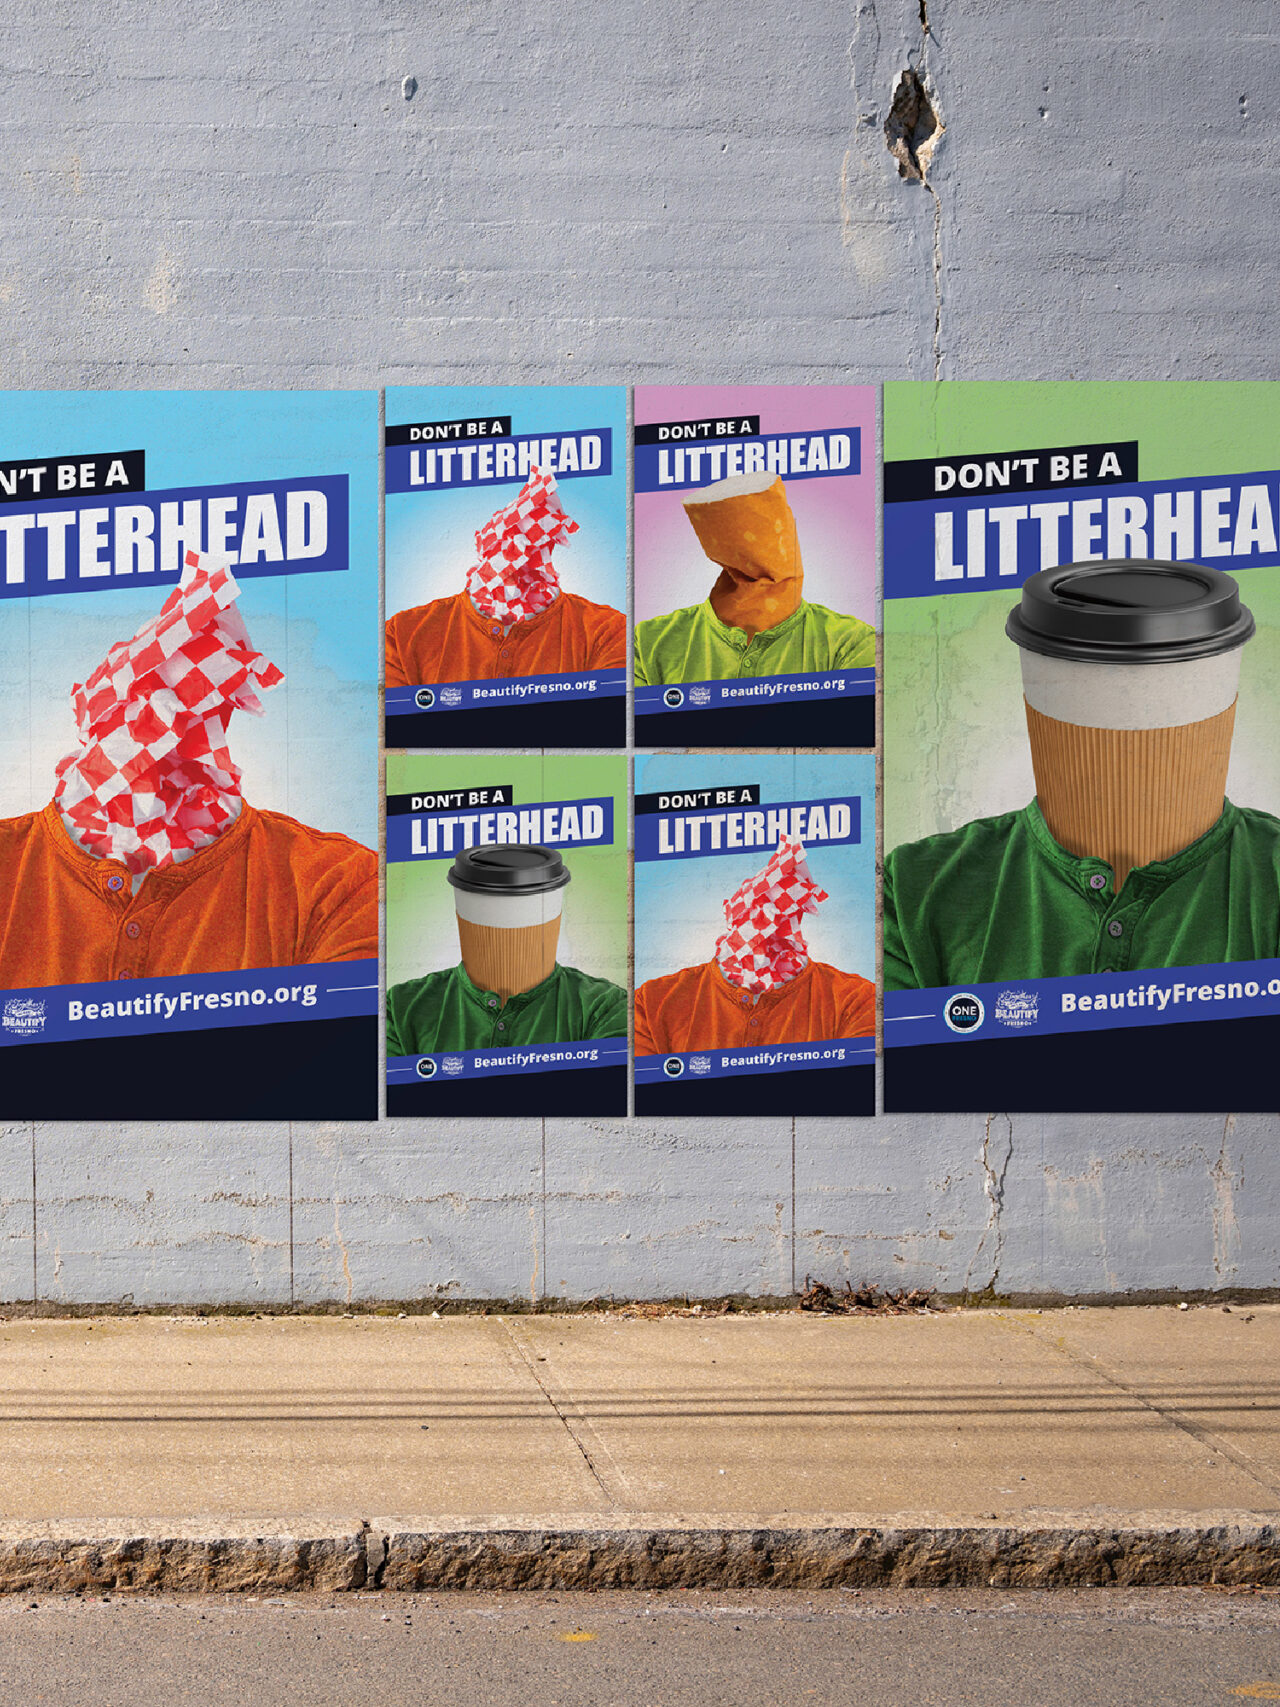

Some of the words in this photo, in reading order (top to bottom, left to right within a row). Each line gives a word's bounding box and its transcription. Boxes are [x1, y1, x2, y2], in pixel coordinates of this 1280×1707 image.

[410, 423, 463, 441] DON'T
[468, 422, 487, 436] BE
[491, 420, 504, 434] A
[659, 423, 712, 441] DON'T
[717, 421, 736, 435] BE
[740, 420, 752, 434] A
[410, 435, 602, 486] LITTERHEAD
[659, 435, 851, 485] LITTERHEAD
[58, 463, 96, 491] BE
[105, 460, 129, 486] A
[934, 458, 1040, 492] DON'T
[1051, 454, 1088, 482] BE
[1097, 451, 1122, 477] A
[934, 483, 1280, 582] LITTERHEA
[473, 680, 597, 699] BeautifyFresno.org
[722, 680, 845, 698] BeautifyFresno.org
[411, 792, 464, 810] DON'T
[469, 791, 488, 805] BE
[493, 790, 505, 803] A
[659, 792, 712, 810] DON'T
[717, 790, 736, 804] BE
[740, 789, 752, 803] A
[411, 804, 604, 855] LITTERHEAD
[659, 804, 851, 854] LITTERHEAD
[68, 983, 318, 1022] BeautifyFresno.org
[1061, 978, 1280, 1013] BeautifyFresno.o
[952, 1006, 977, 1015] ONE
[995, 1008, 1039, 1019] BEAUTIFY
[2, 1016, 47, 1027] BEAUTIFY
[474, 1049, 598, 1068] BeautifyFresno.org
[722, 1049, 845, 1067] BeautifyFresno.org
